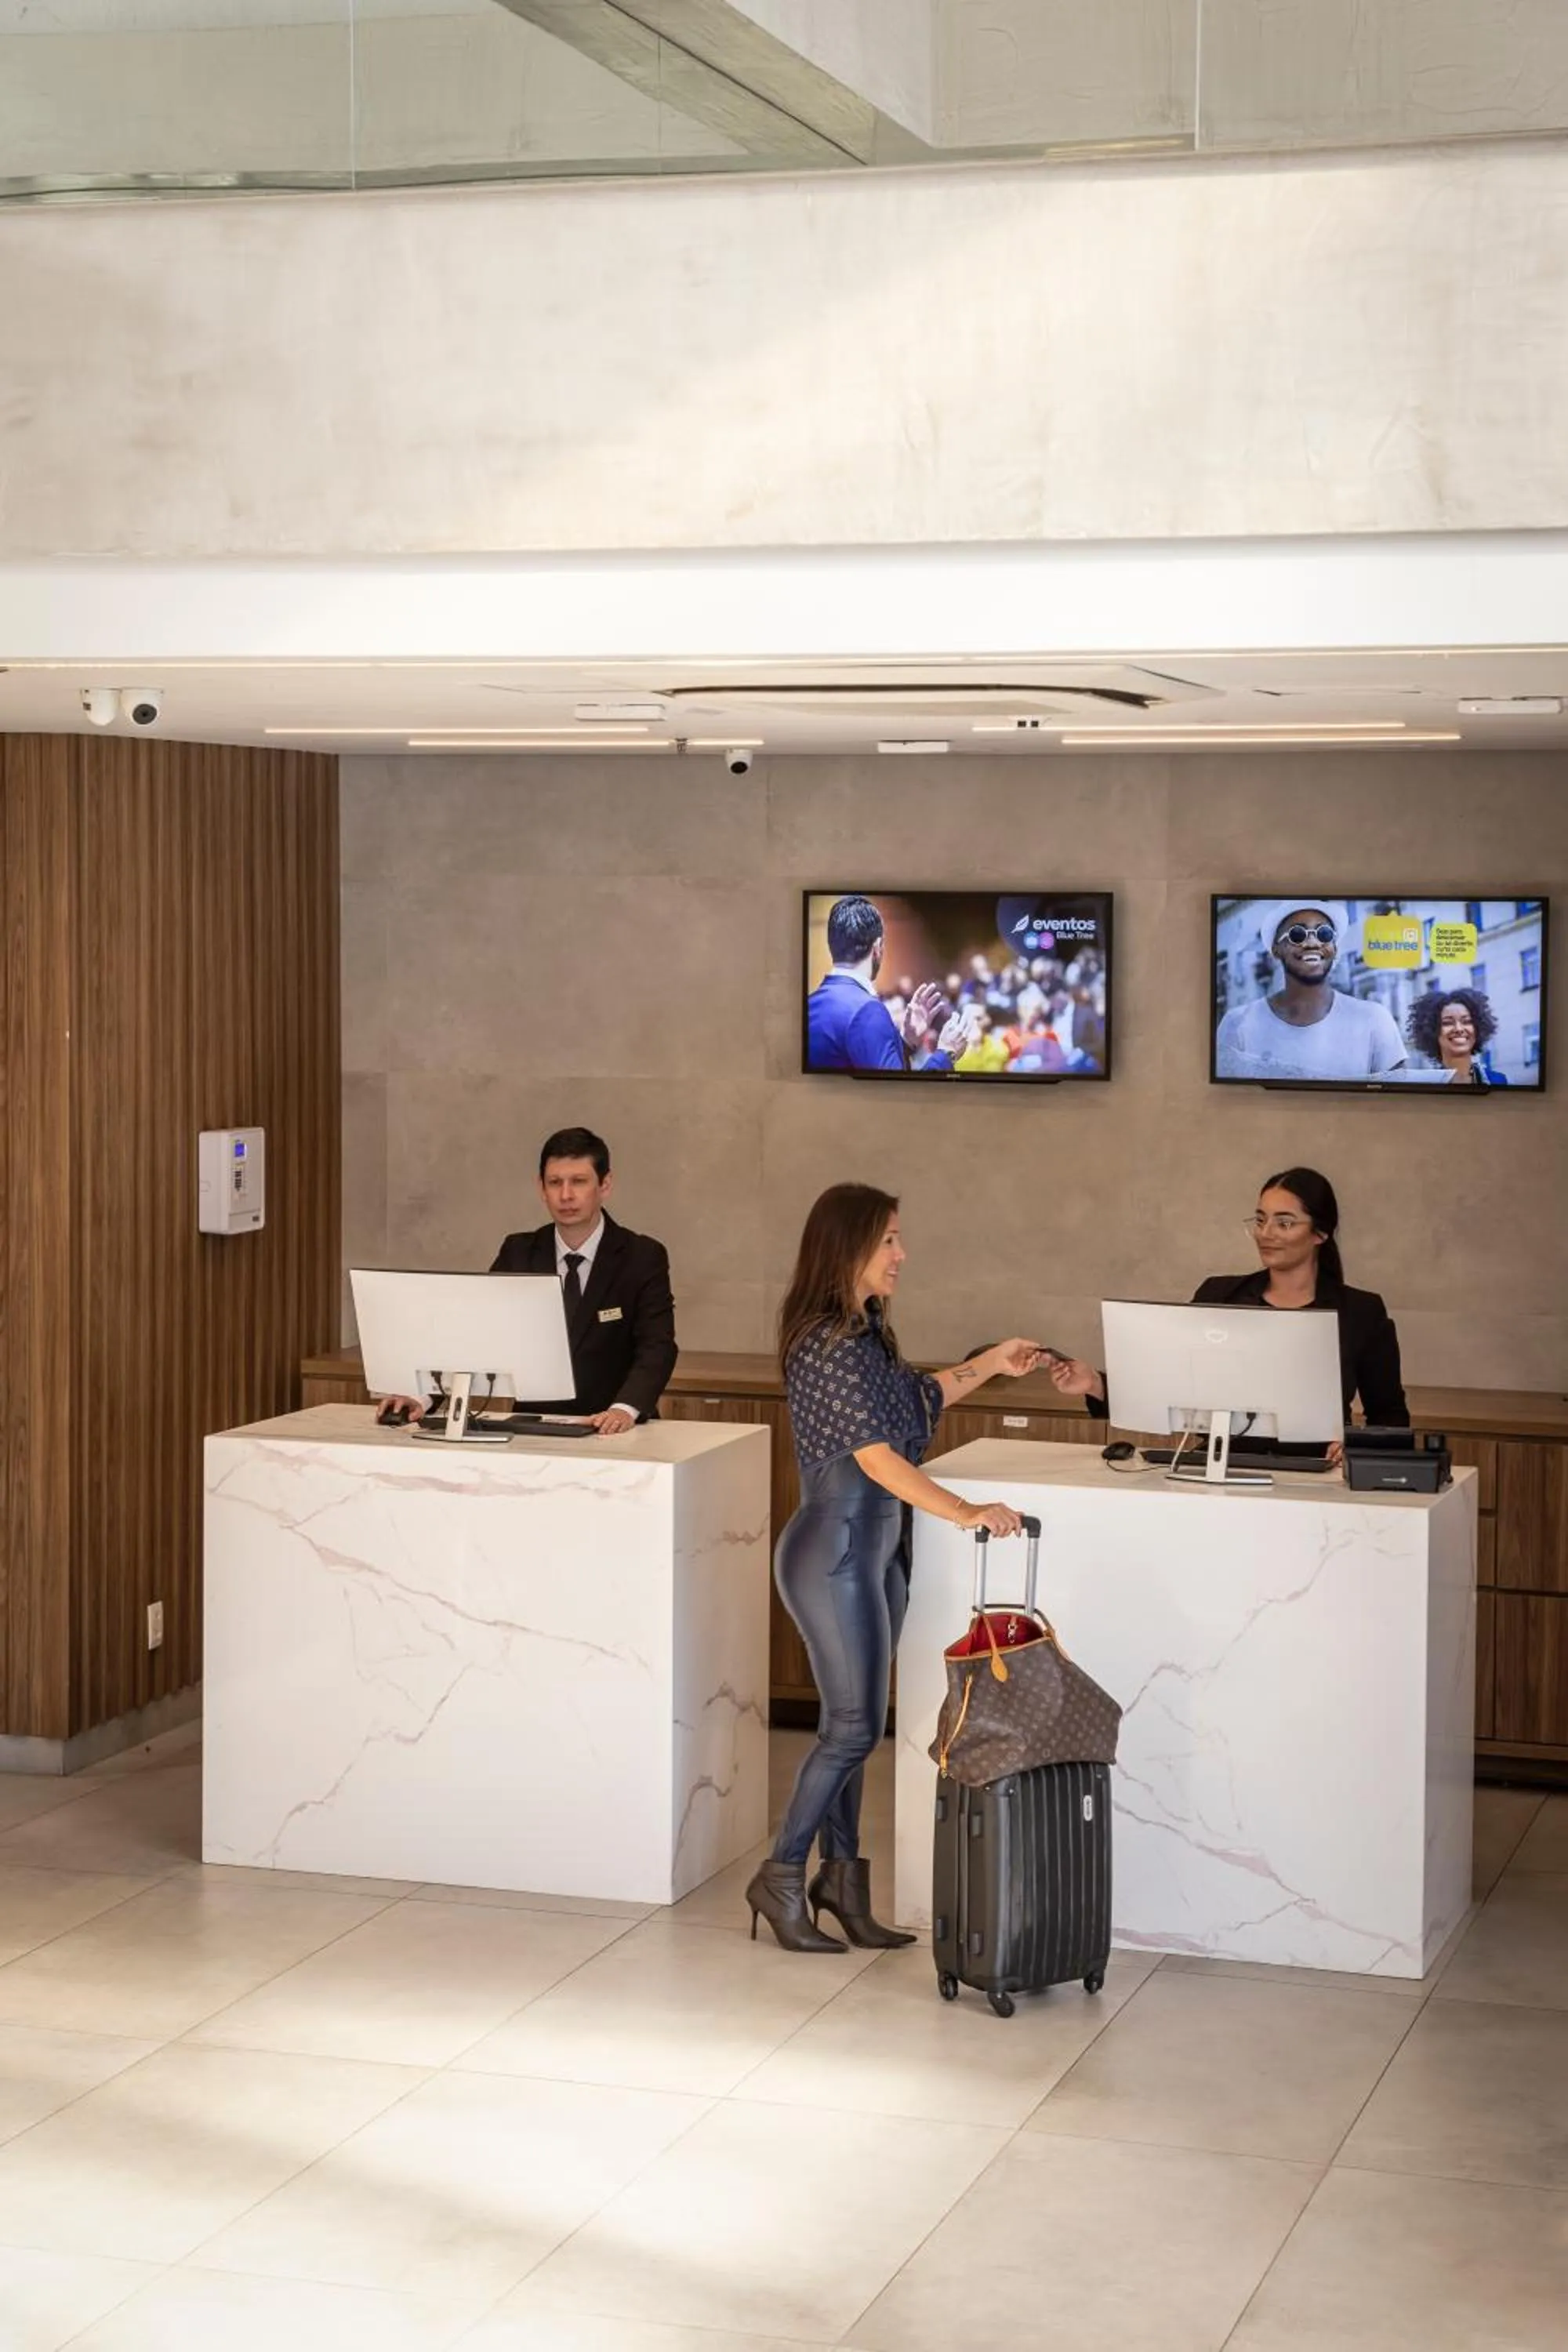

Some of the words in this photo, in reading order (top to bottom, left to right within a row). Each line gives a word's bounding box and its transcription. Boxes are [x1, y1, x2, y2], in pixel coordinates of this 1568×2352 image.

[1033, 917, 1096, 931] eventos
[1367, 940, 1392, 950] blue
[1394, 941, 1418, 950] tree
